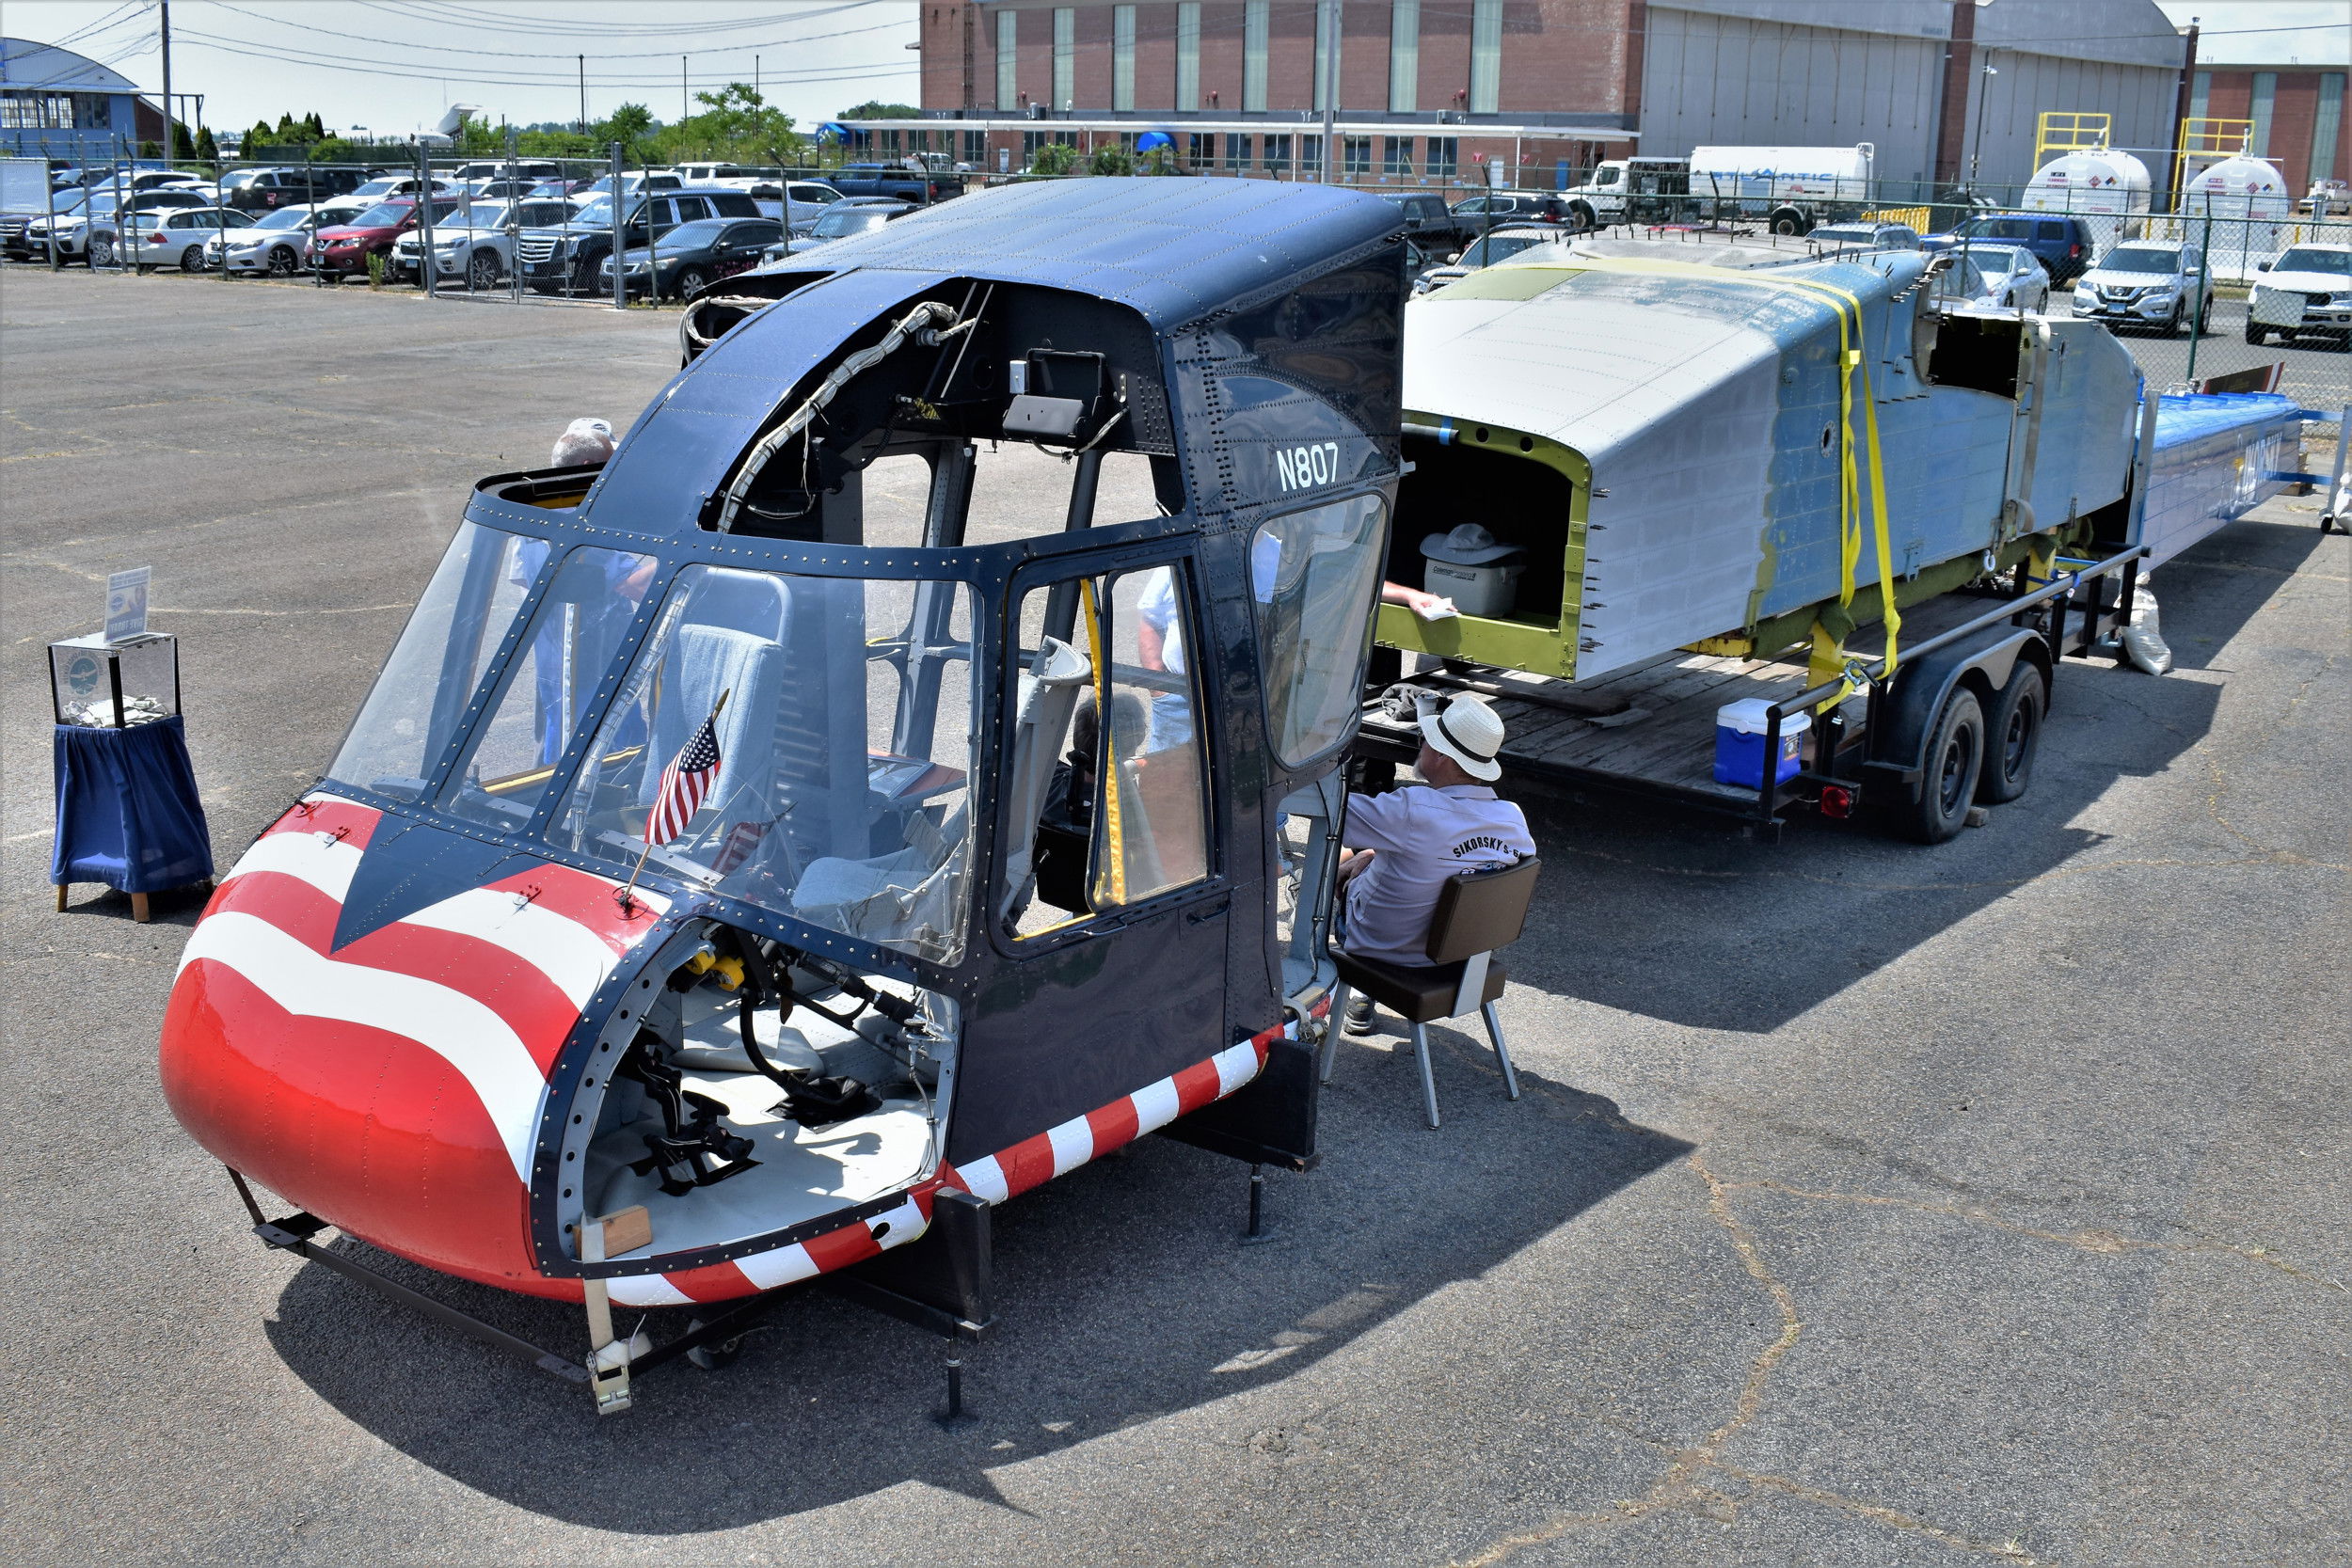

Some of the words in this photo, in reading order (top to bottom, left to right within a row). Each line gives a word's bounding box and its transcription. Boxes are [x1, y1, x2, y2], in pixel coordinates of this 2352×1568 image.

[1276, 441, 1339, 492] N807
[1453, 836, 1503, 858] SIKORSKY
[1503, 845, 1519, 858] S-6
